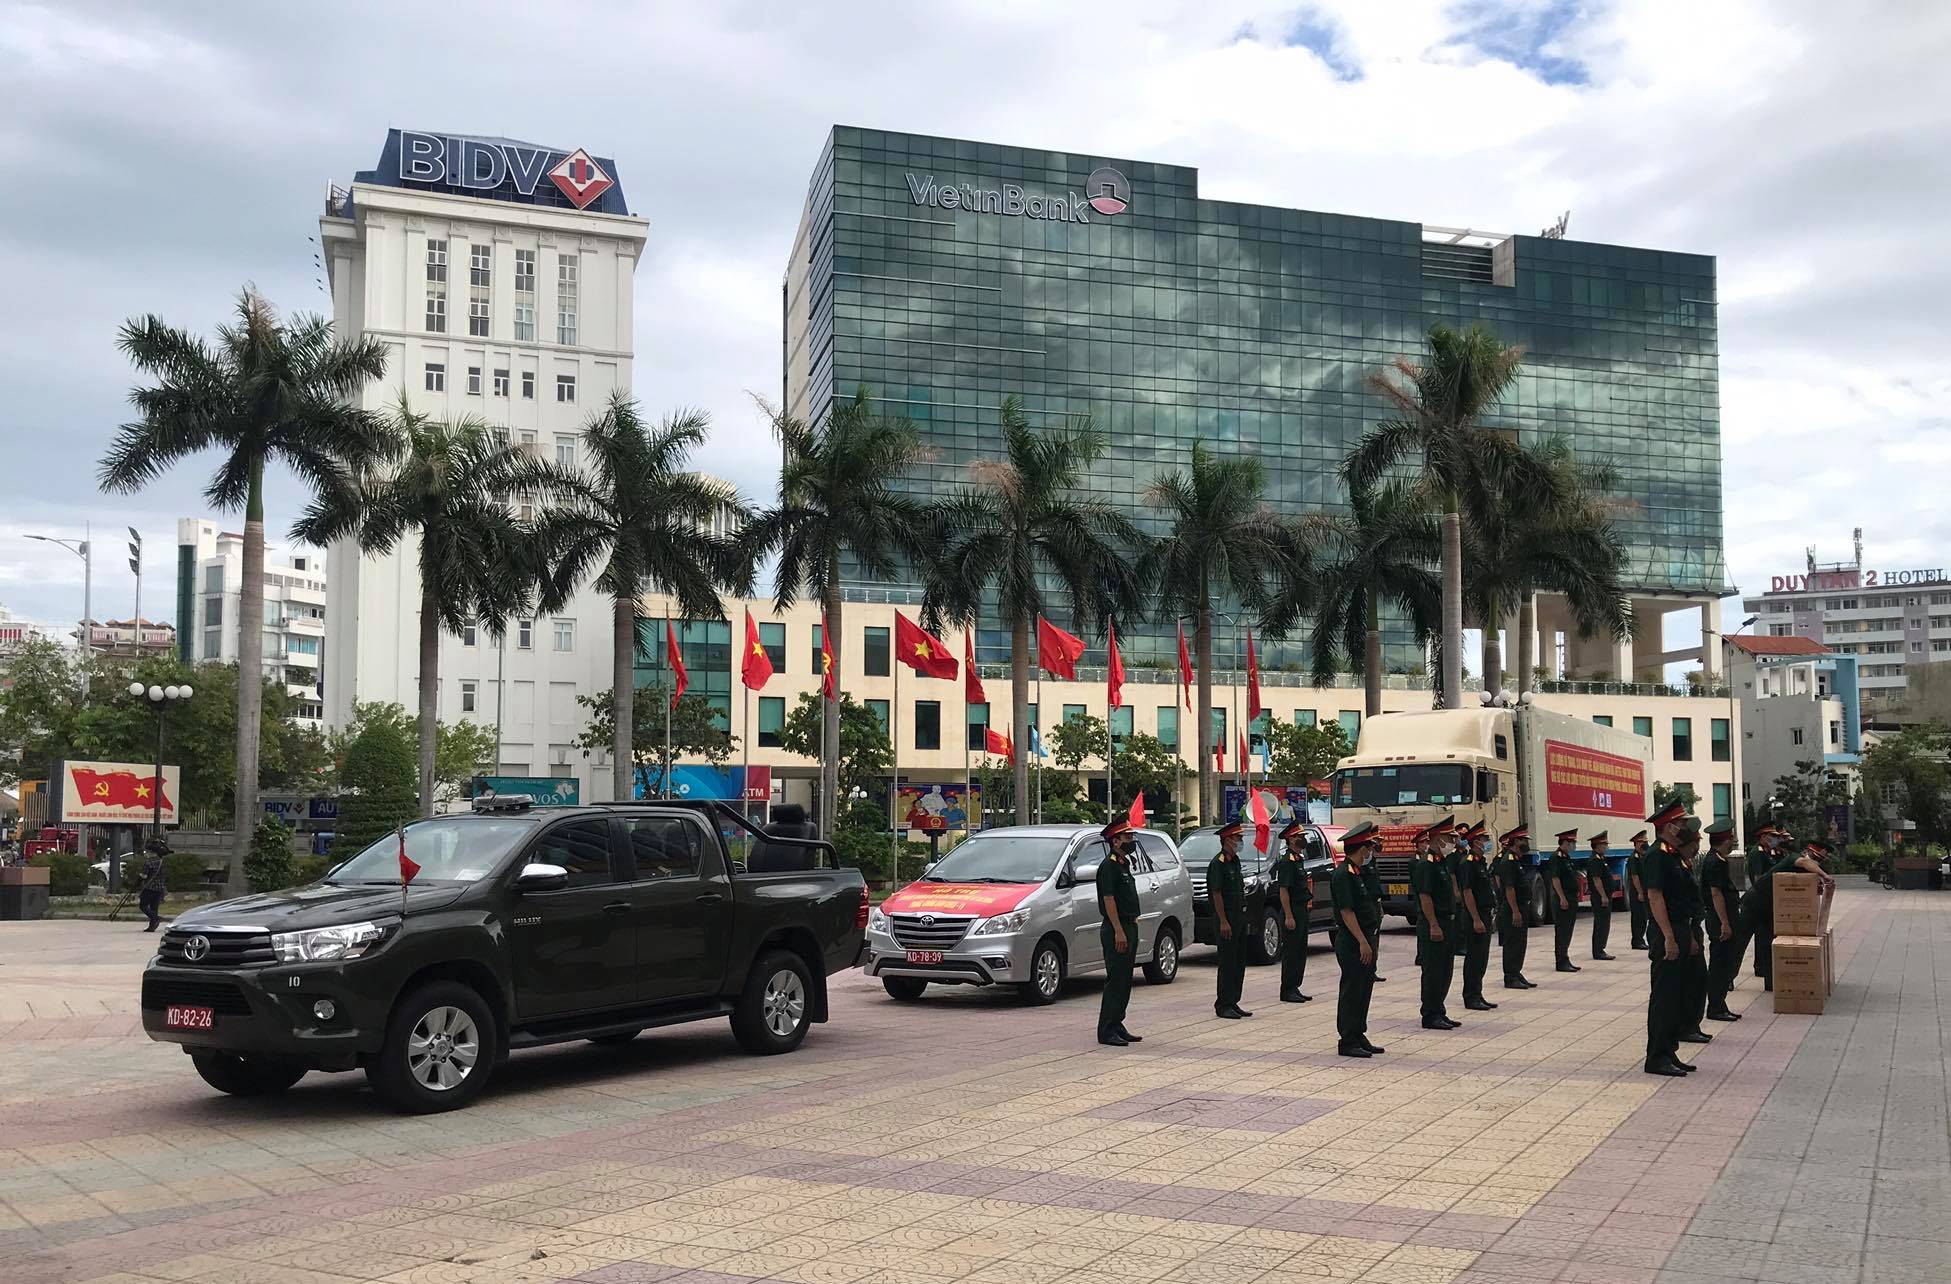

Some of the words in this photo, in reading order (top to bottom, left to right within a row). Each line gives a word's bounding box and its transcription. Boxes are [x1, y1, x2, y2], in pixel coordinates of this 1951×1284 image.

[400, 130, 550, 196] BIDV
[904, 173, 1089, 223] VietinBank
[1771, 574, 1809, 593] DUY
[1865, 569, 1878, 586] 2
[1883, 568, 1948, 585] HOTEL
[264, 802, 293, 813] BIDV
[167, 1008, 212, 1027] KD-82-26
